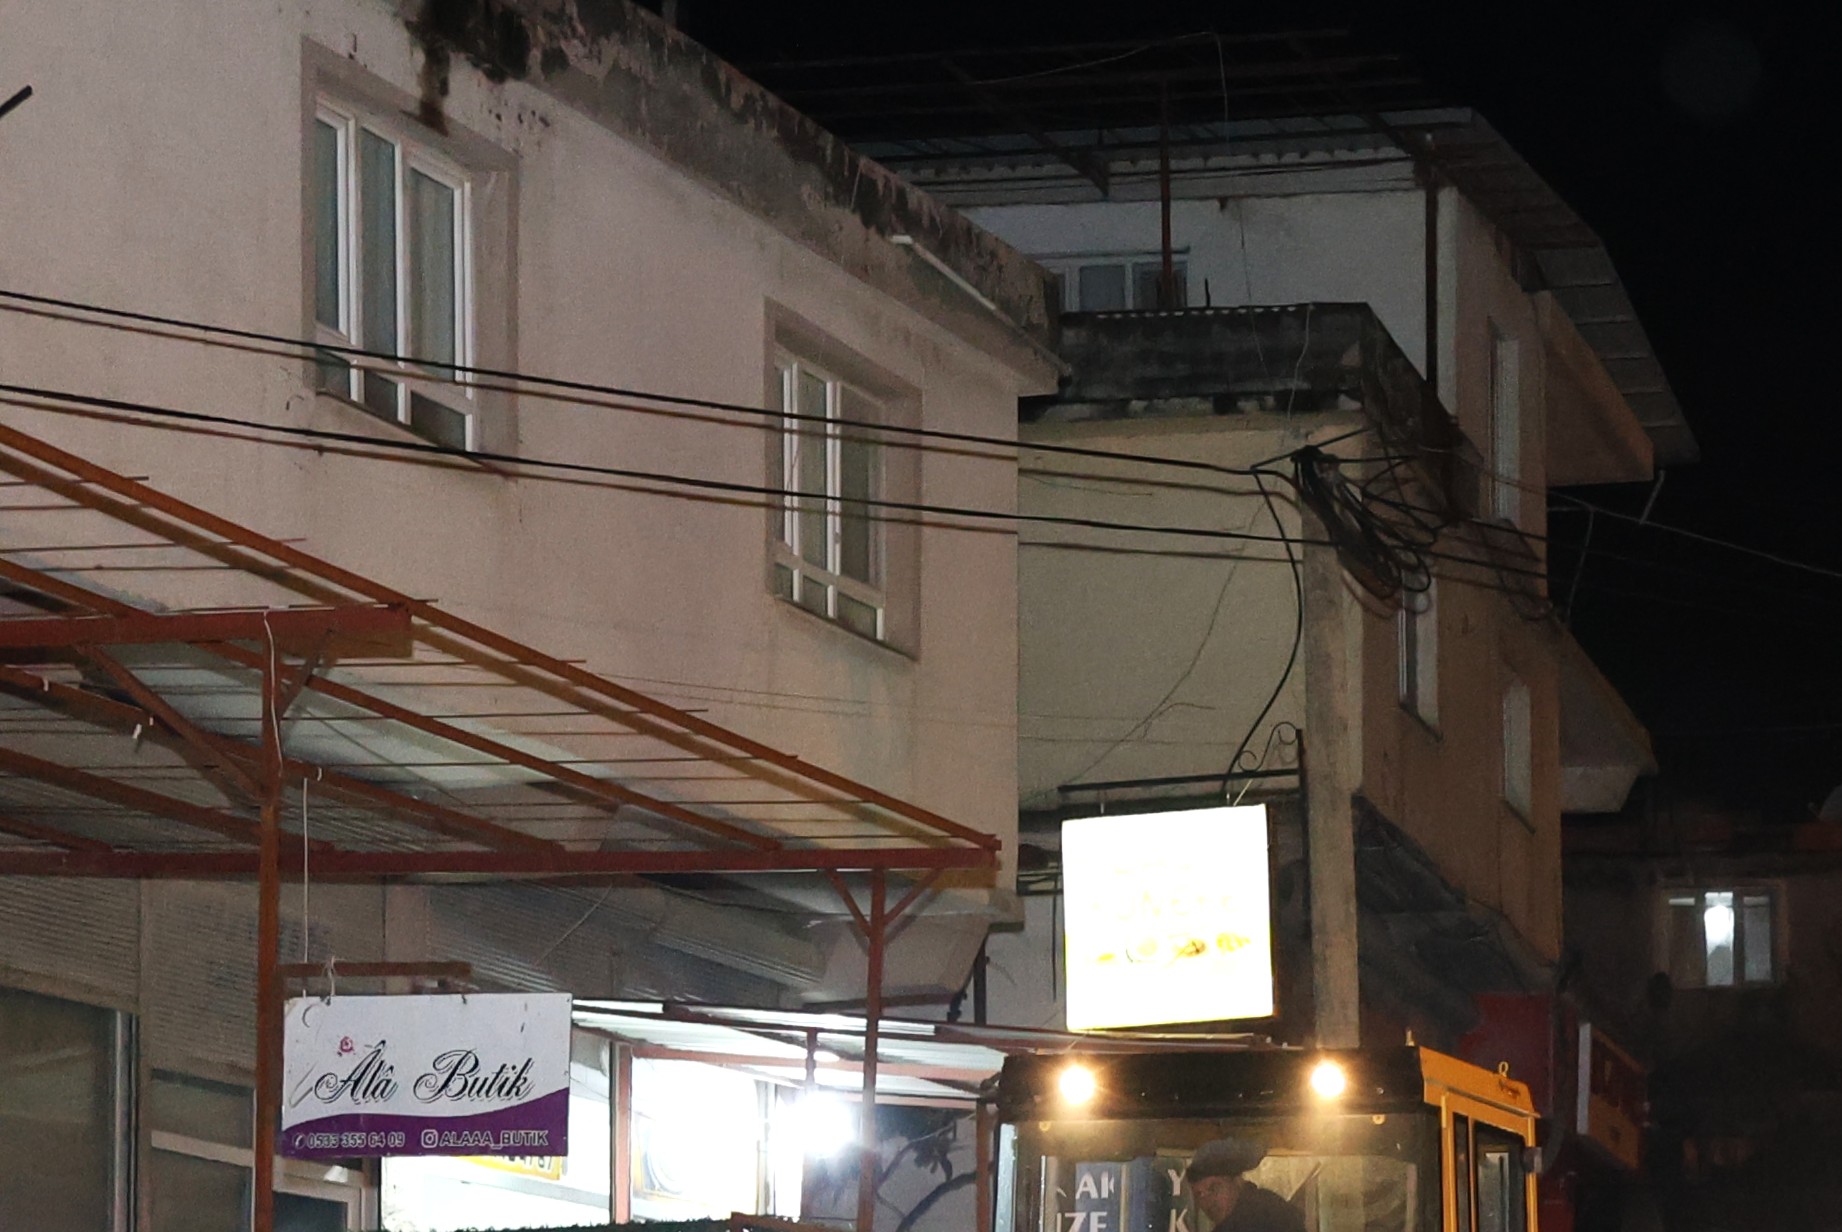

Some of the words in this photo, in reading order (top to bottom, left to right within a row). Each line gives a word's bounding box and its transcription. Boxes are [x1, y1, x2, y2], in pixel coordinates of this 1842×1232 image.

[413, 1048, 534, 1103] Butik
[388, 1131, 406, 1148] 09
[440, 1130, 549, 1149] ALAAA_BUTIK
